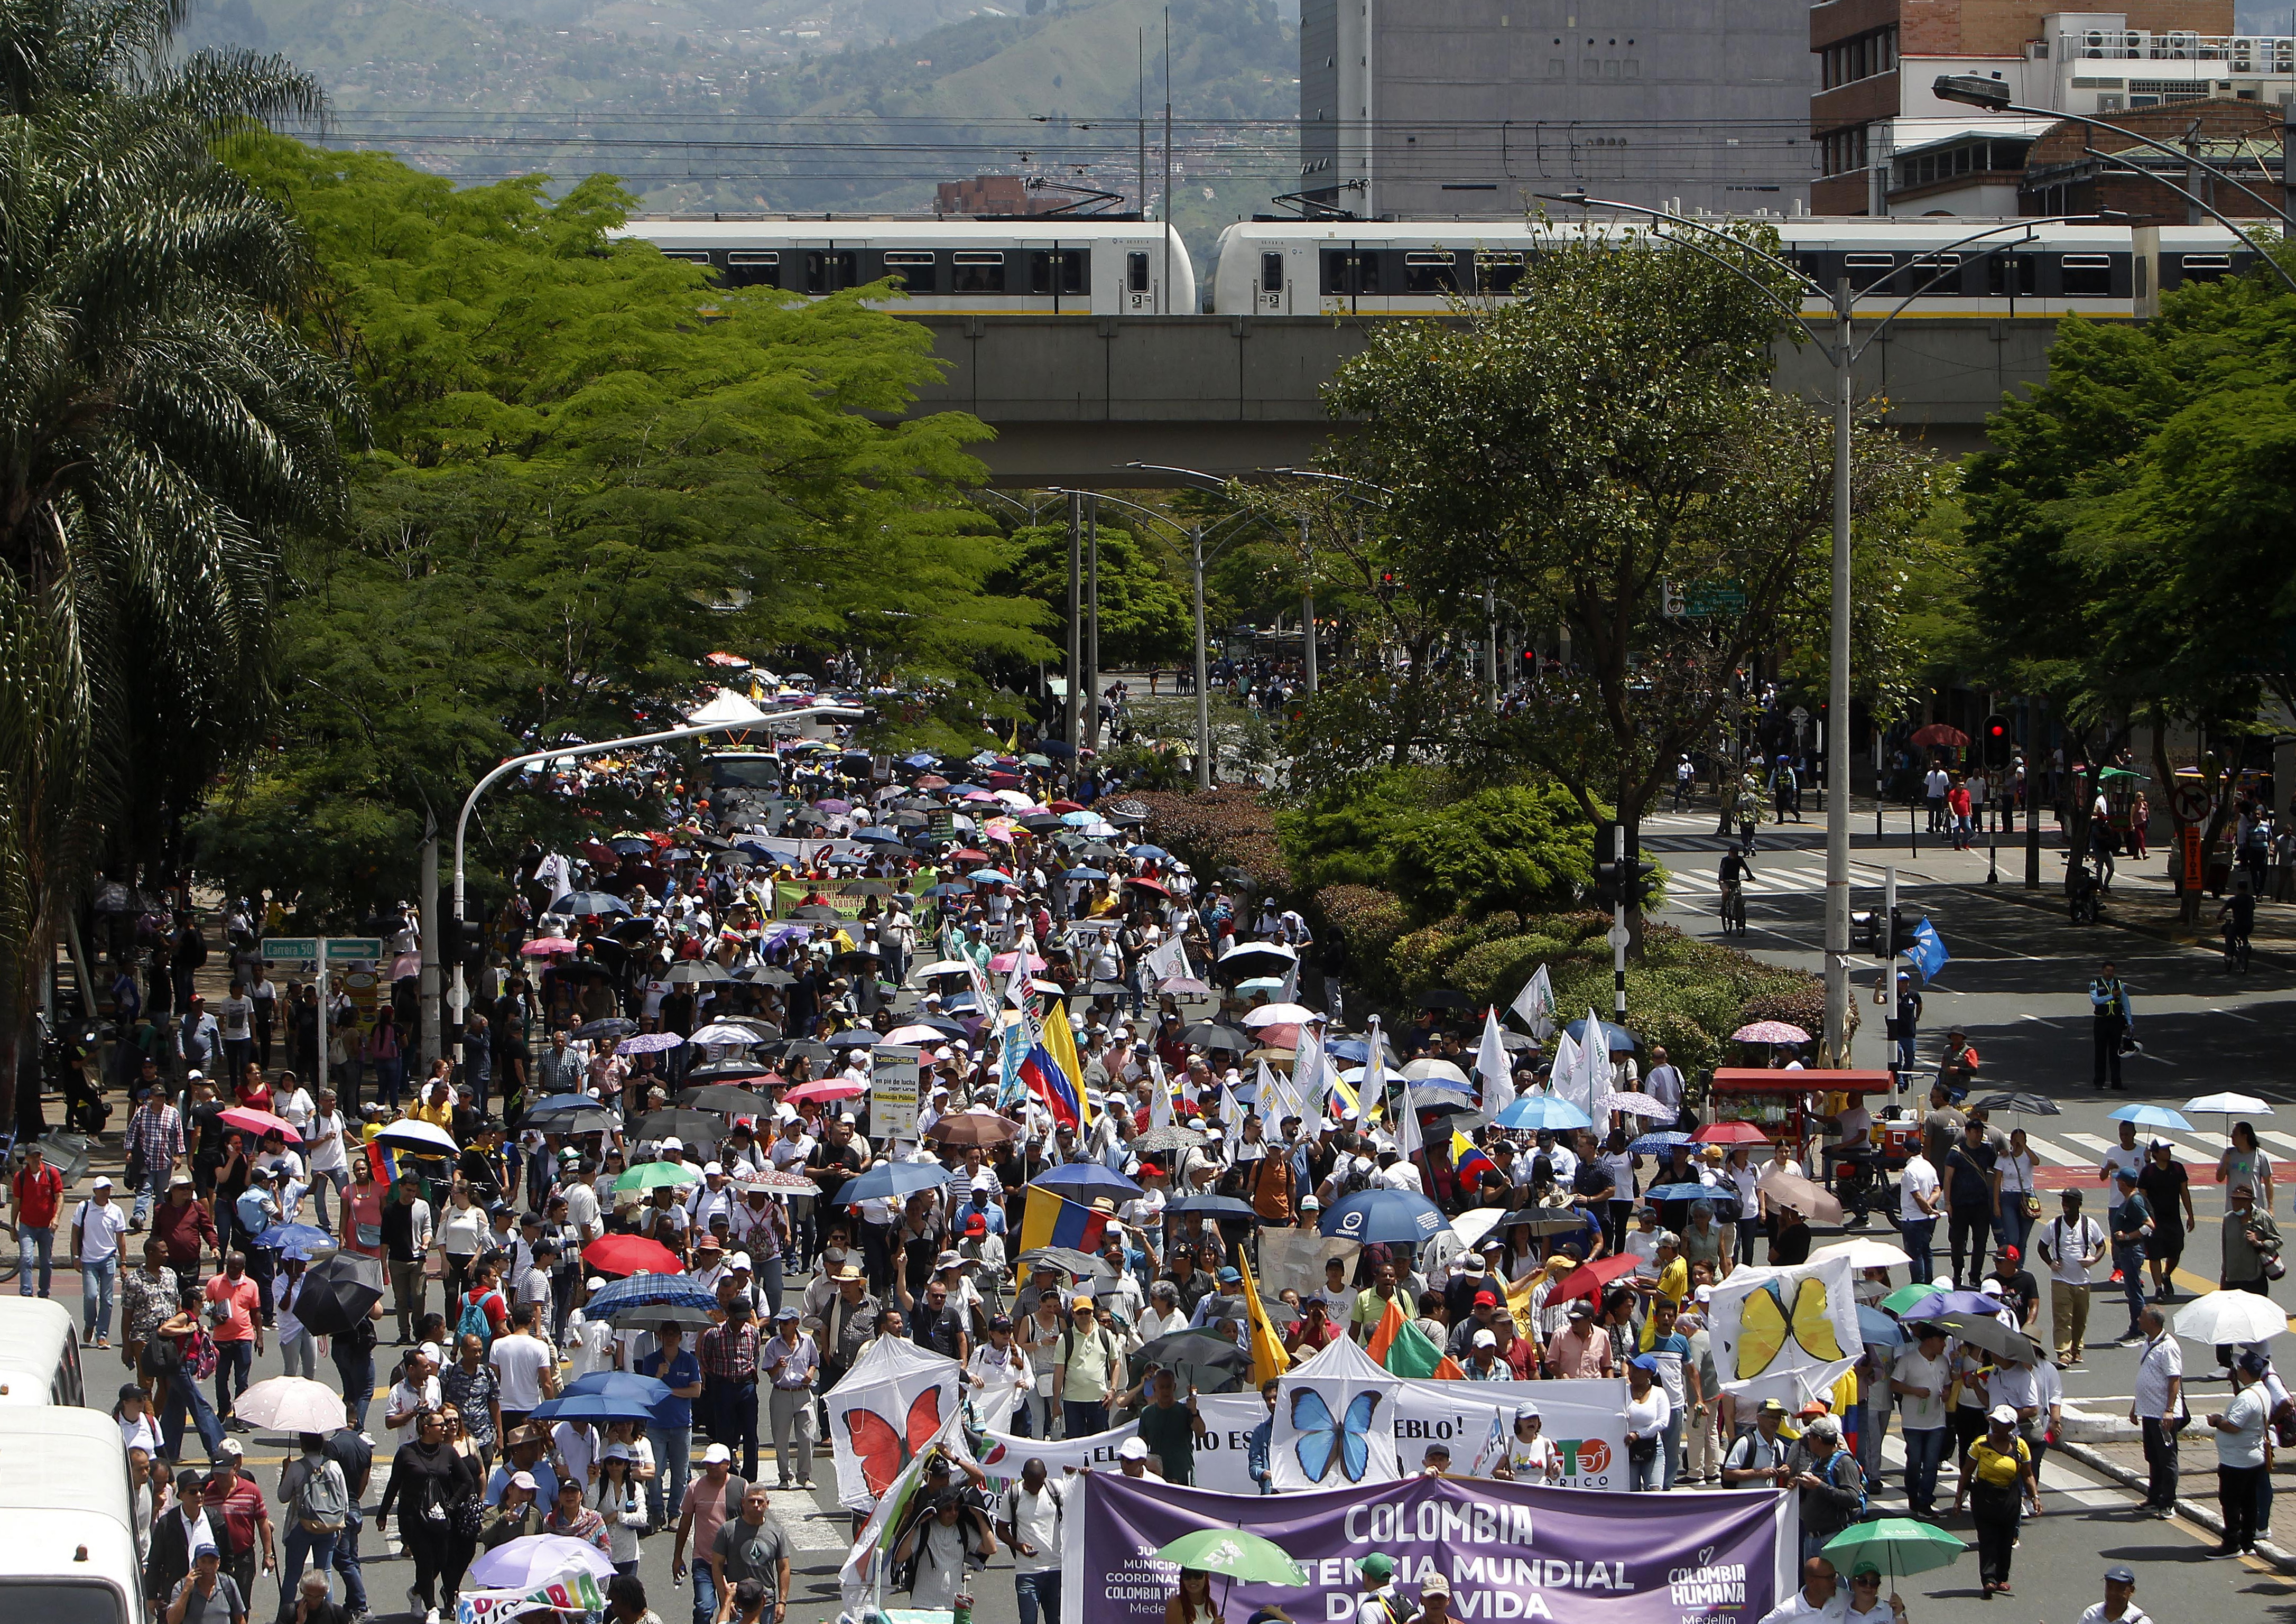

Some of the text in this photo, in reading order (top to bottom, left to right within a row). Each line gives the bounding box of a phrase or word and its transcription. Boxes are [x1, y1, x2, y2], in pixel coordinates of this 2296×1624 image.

[834, 899, 864, 908] ABUSOS
[267, 943, 312, 955] Carrera 50
[1345, 1500, 1533, 1545] COLOMBIA
[1124, 1559, 1183, 1571] MUNICIPA
[1453, 1555, 1635, 1590] MUNDIAL
[1668, 1563, 1746, 1585] COLOMBIA
[1105, 1586, 1161, 1600] COLOMBIA
[1671, 1582, 1746, 1605] HUMANA
[1452, 1590, 1554, 1620] VIDA
